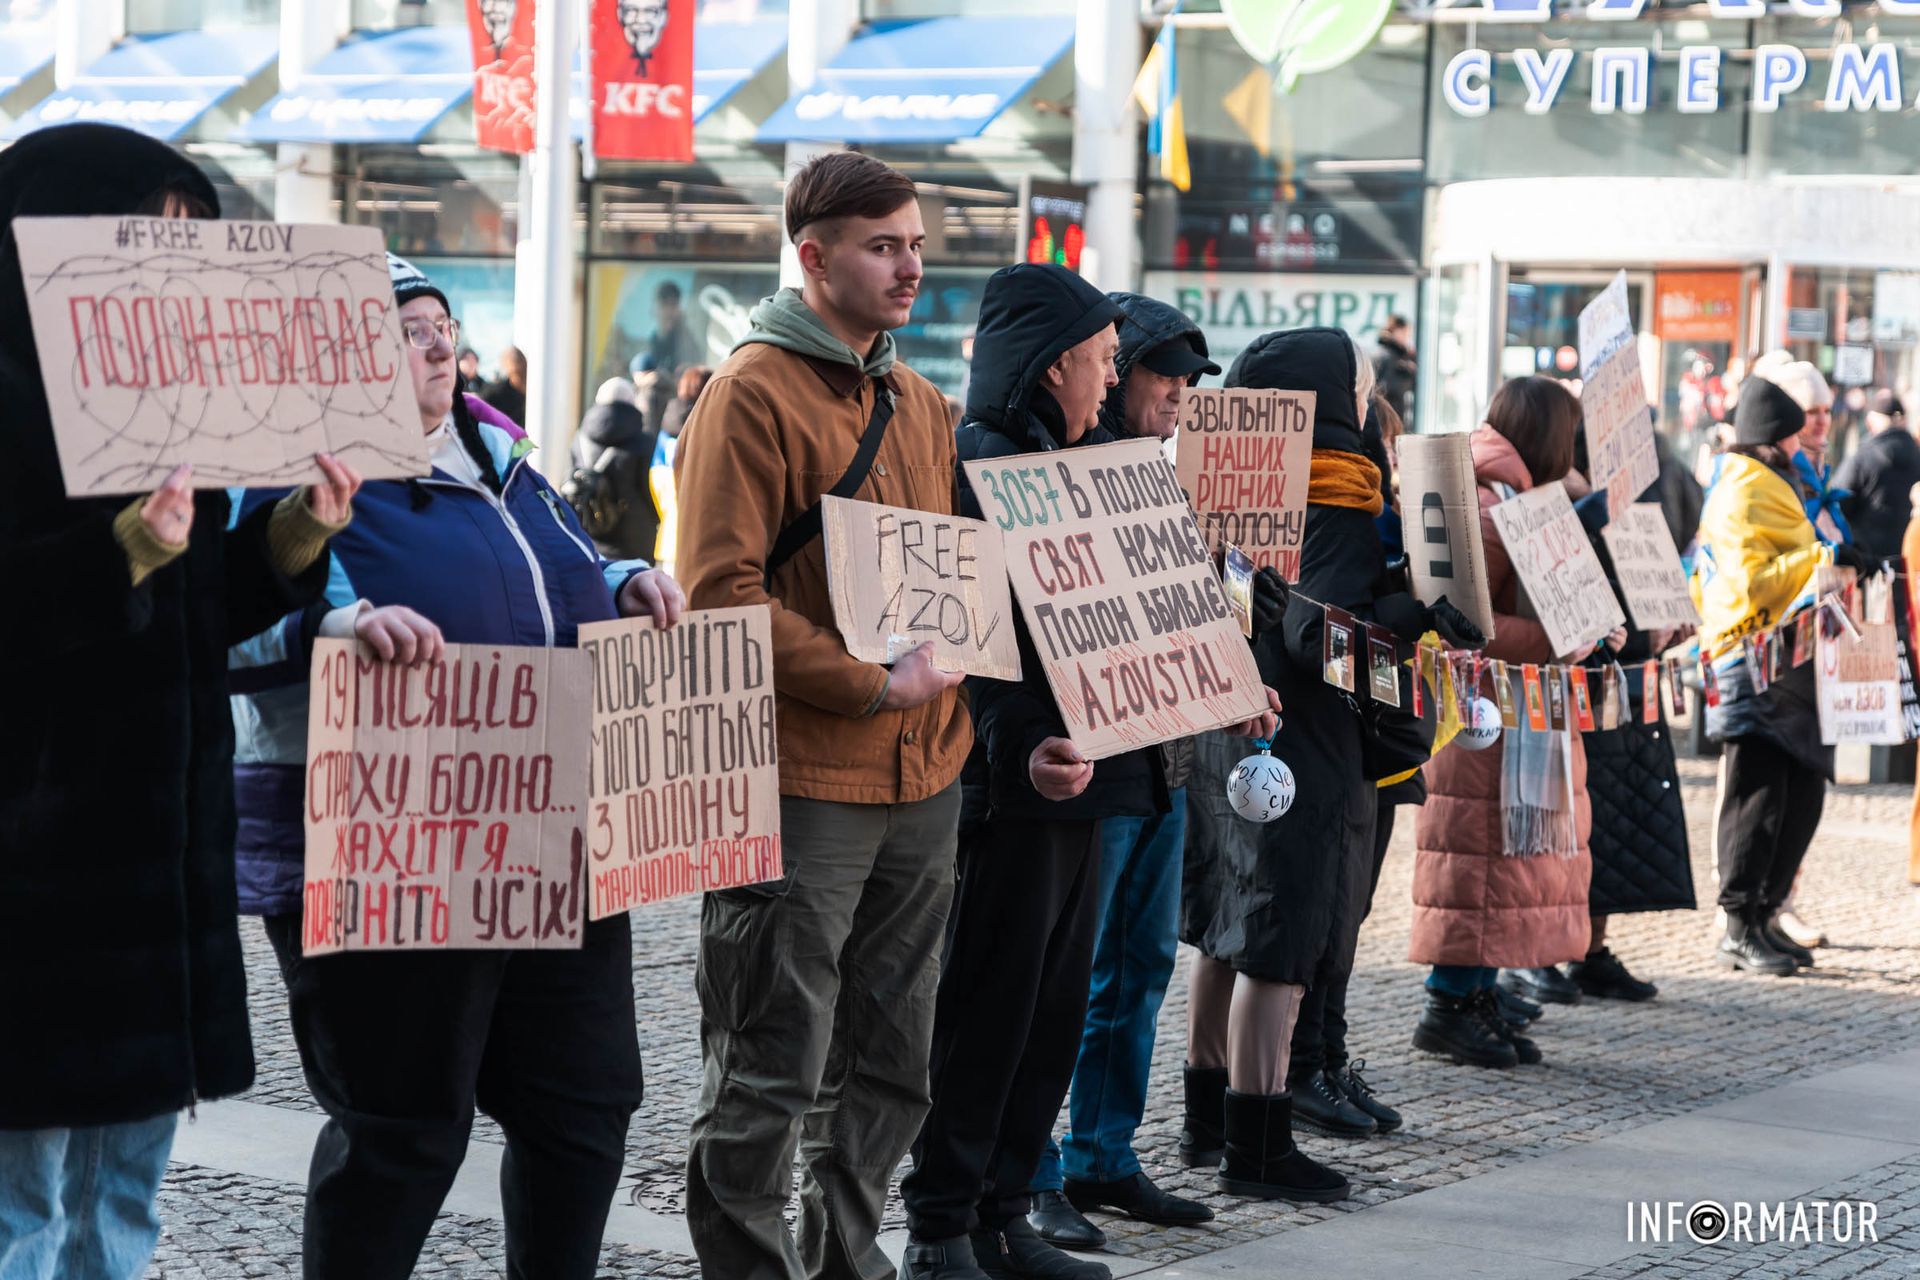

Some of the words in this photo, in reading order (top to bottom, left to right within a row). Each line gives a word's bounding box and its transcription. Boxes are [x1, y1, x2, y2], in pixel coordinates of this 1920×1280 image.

[602, 82, 684, 118] KFC
[1442, 43, 1920, 117] СУПЕРМ
[115, 219, 203, 250] #FREE
[227, 223, 296, 253] AZOV
[69, 295, 395, 389] ПОЛОН-ВБИВАЄ
[1175, 286, 1400, 334] БІЛЬЯРД
[1185, 389, 1307, 433] ЗВІЛЬНІТЬ
[1202, 436, 1287, 472] НАШИХ
[980, 466, 1063, 532] 3057
[1196, 470, 1287, 513] РІДНИХ
[876, 513, 978, 581] FREE
[1204, 510, 1303, 547] ПОЛОНУ
[1028, 531, 1106, 597] СВЯТ
[876, 581, 1000, 652] AZOV
[320, 650, 348, 730] 19
[353, 651, 538, 733] МІСЯЦІВ
[1076, 642, 1233, 732] AZOVSTAL
[589, 713, 651, 799] МОГО
[662, 695, 776, 781] БАТЬКА
[626, 774, 750, 860] ПОЛОНУ
[473, 826, 583, 941] УСІХ!
